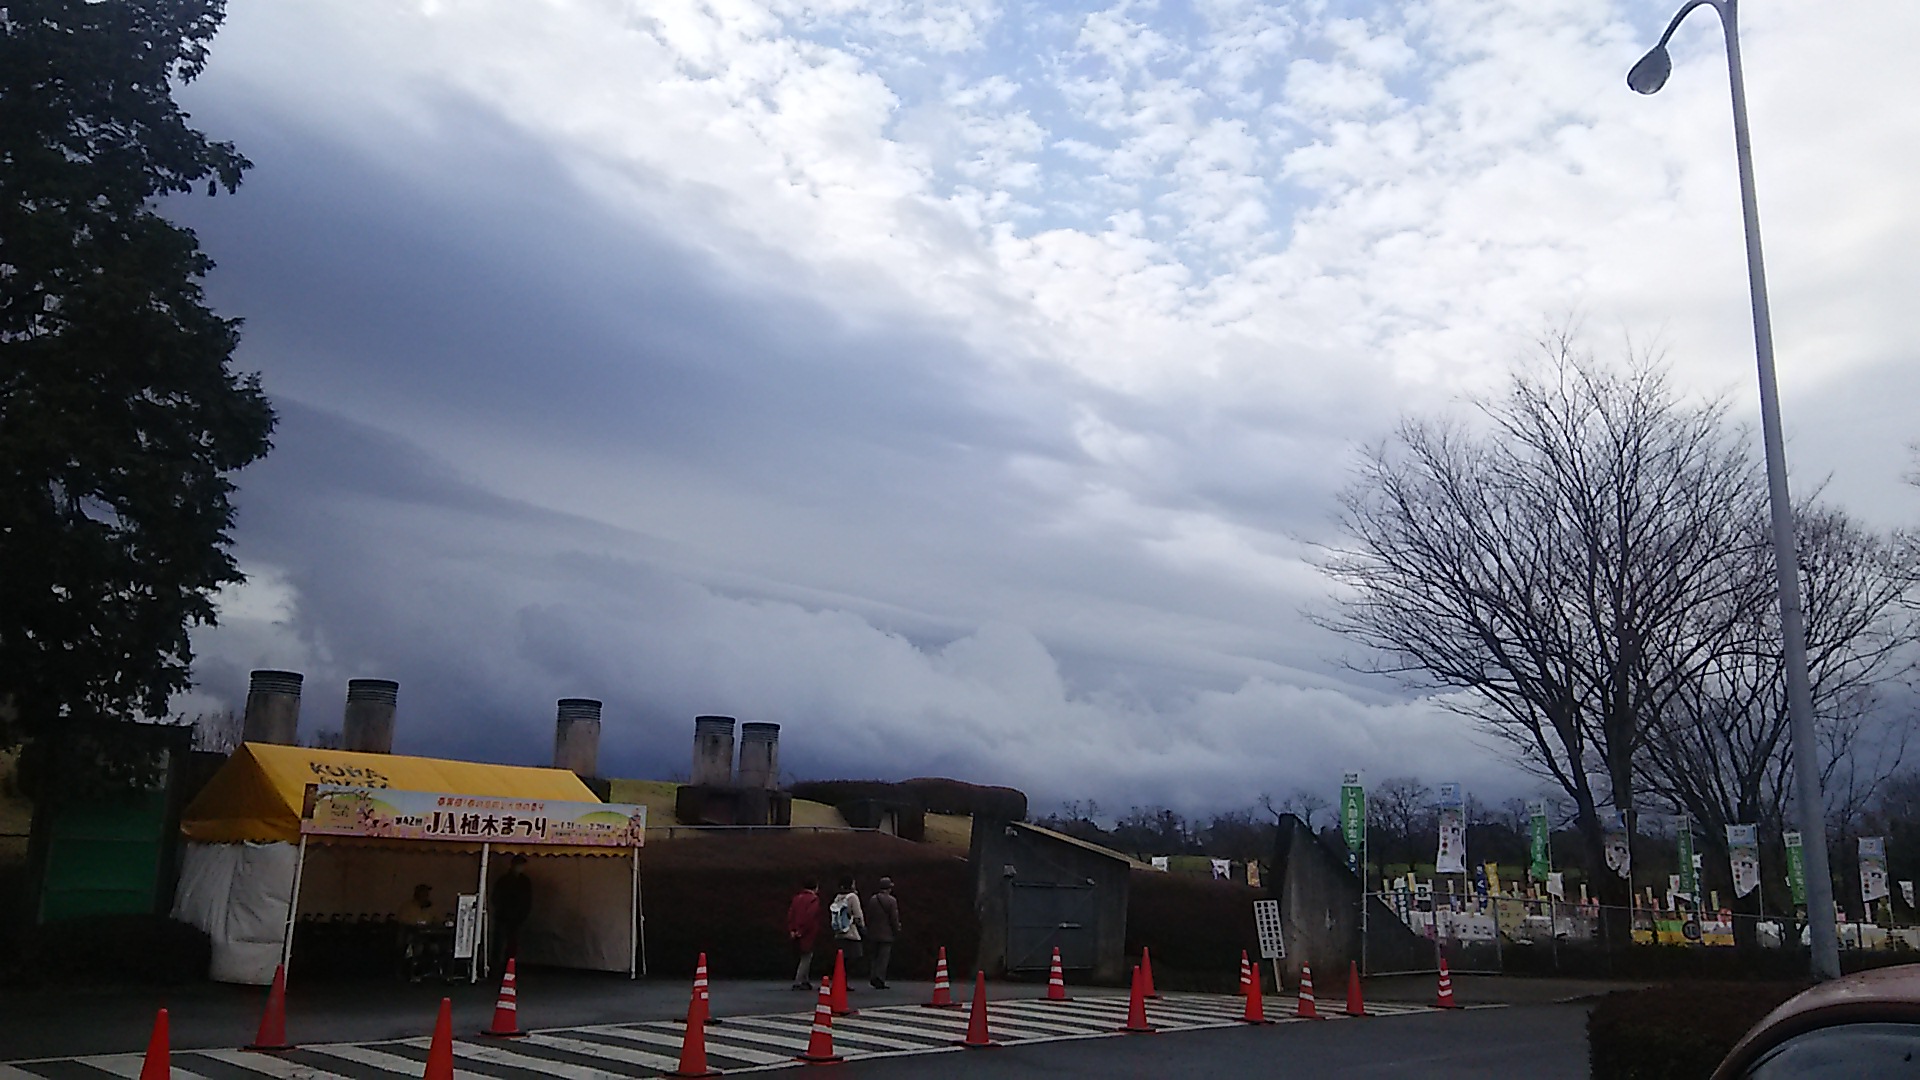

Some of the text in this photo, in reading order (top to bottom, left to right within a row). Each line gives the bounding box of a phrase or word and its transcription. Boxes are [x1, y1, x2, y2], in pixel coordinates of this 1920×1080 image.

[426, 811, 547, 838] JA植木まつり
